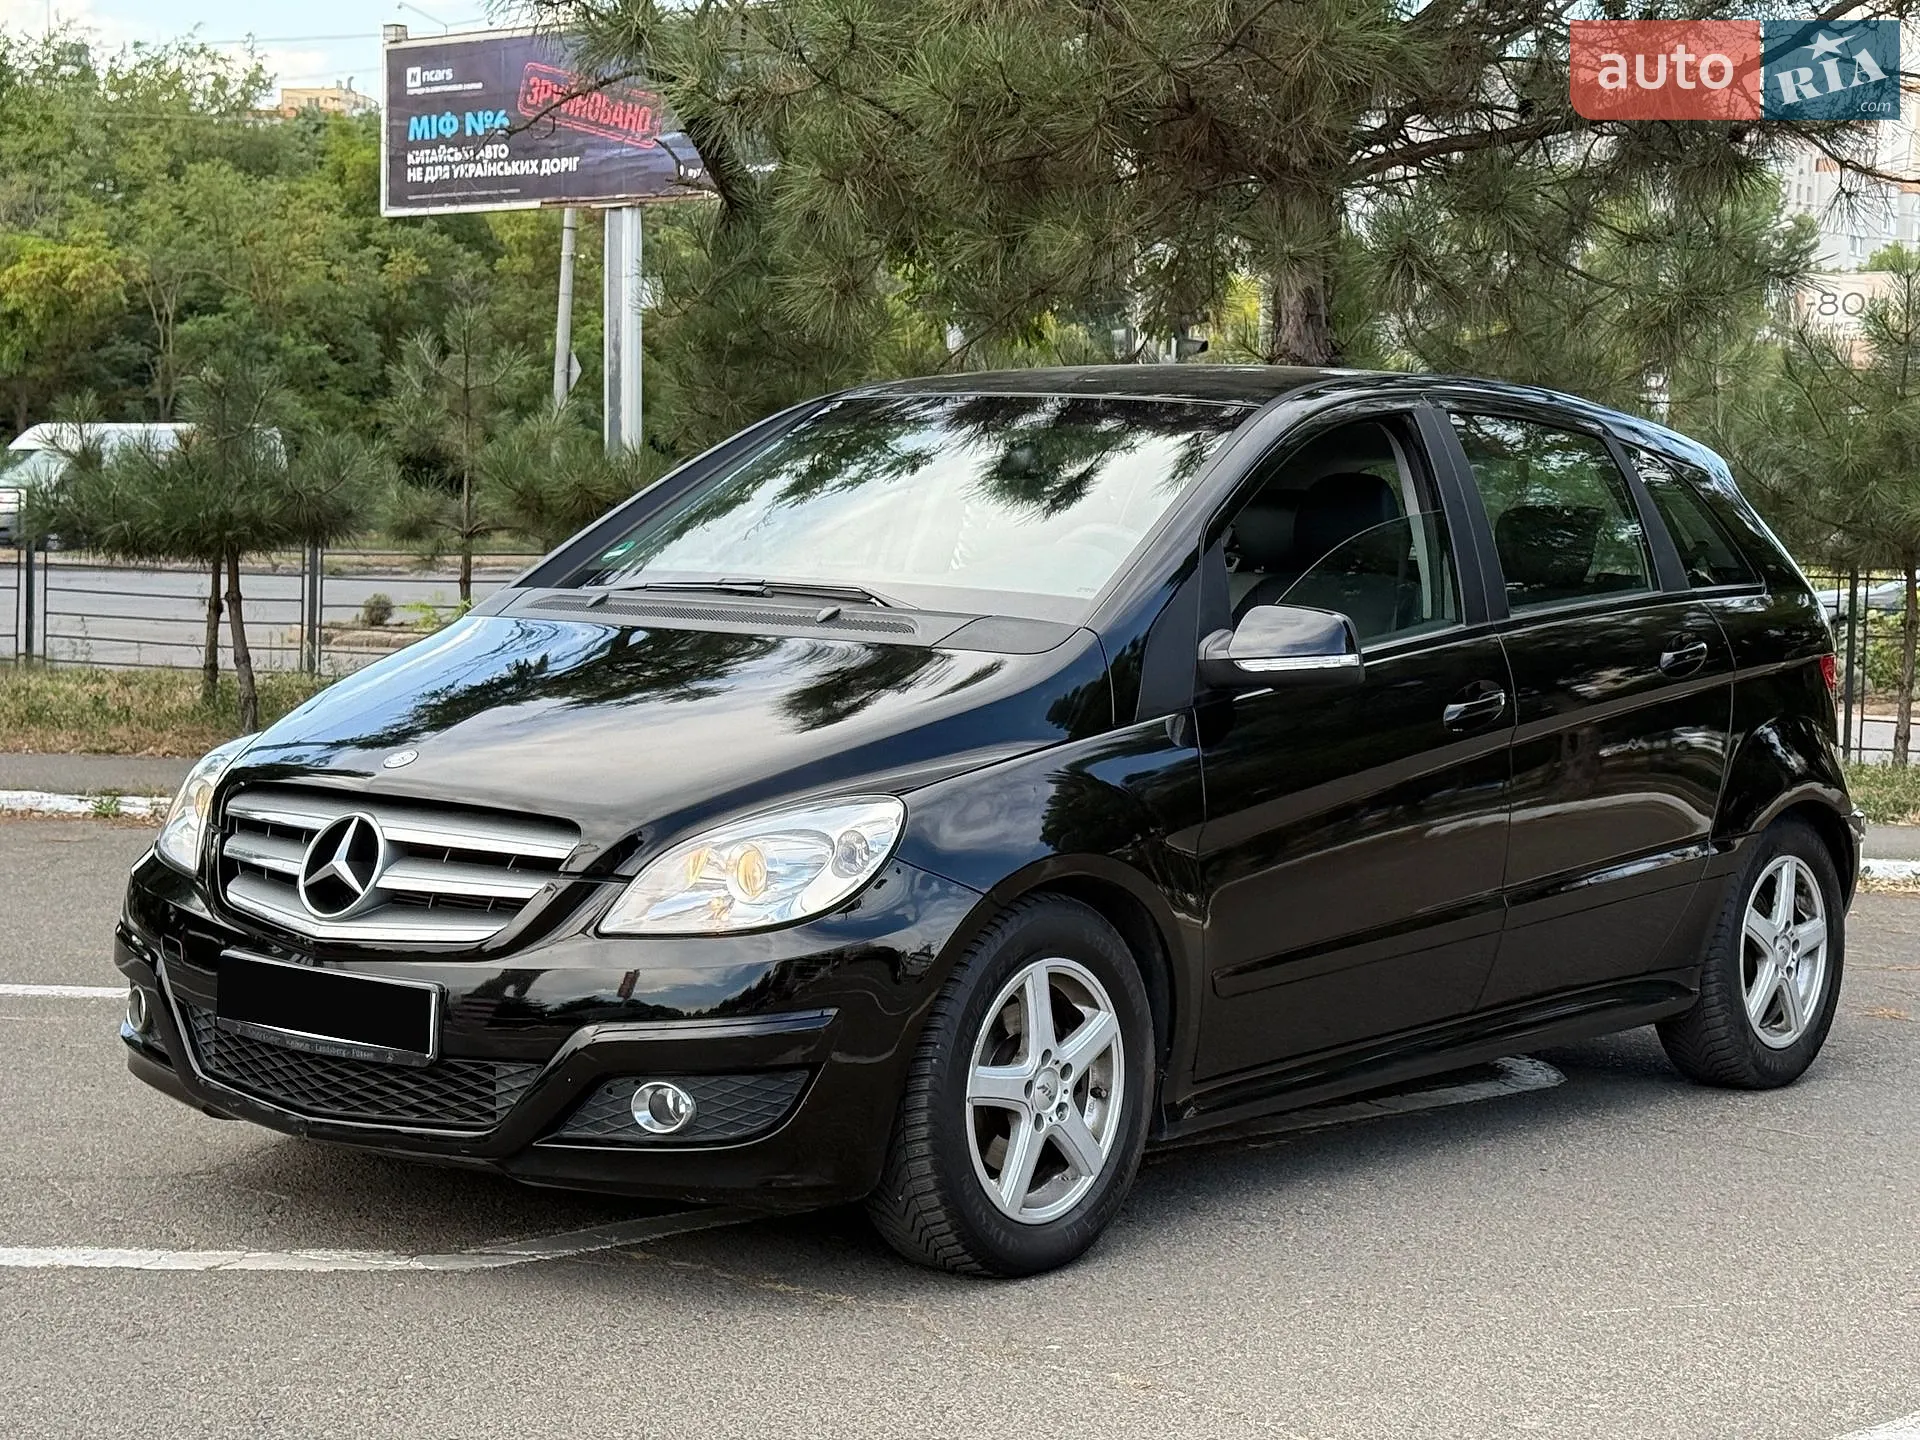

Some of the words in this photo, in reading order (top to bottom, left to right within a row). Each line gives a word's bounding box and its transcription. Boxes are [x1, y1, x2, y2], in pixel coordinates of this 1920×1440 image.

[408, 111, 459, 141] МІФ
[475, 143, 510, 161] АВТО
[407, 167, 423, 183] НЕ
[424, 165, 450, 184] ДЛЯ
[452, 158, 539, 179] УКРАЇНСЬКИХ
[540, 156, 580, 176] ДОРІГ
